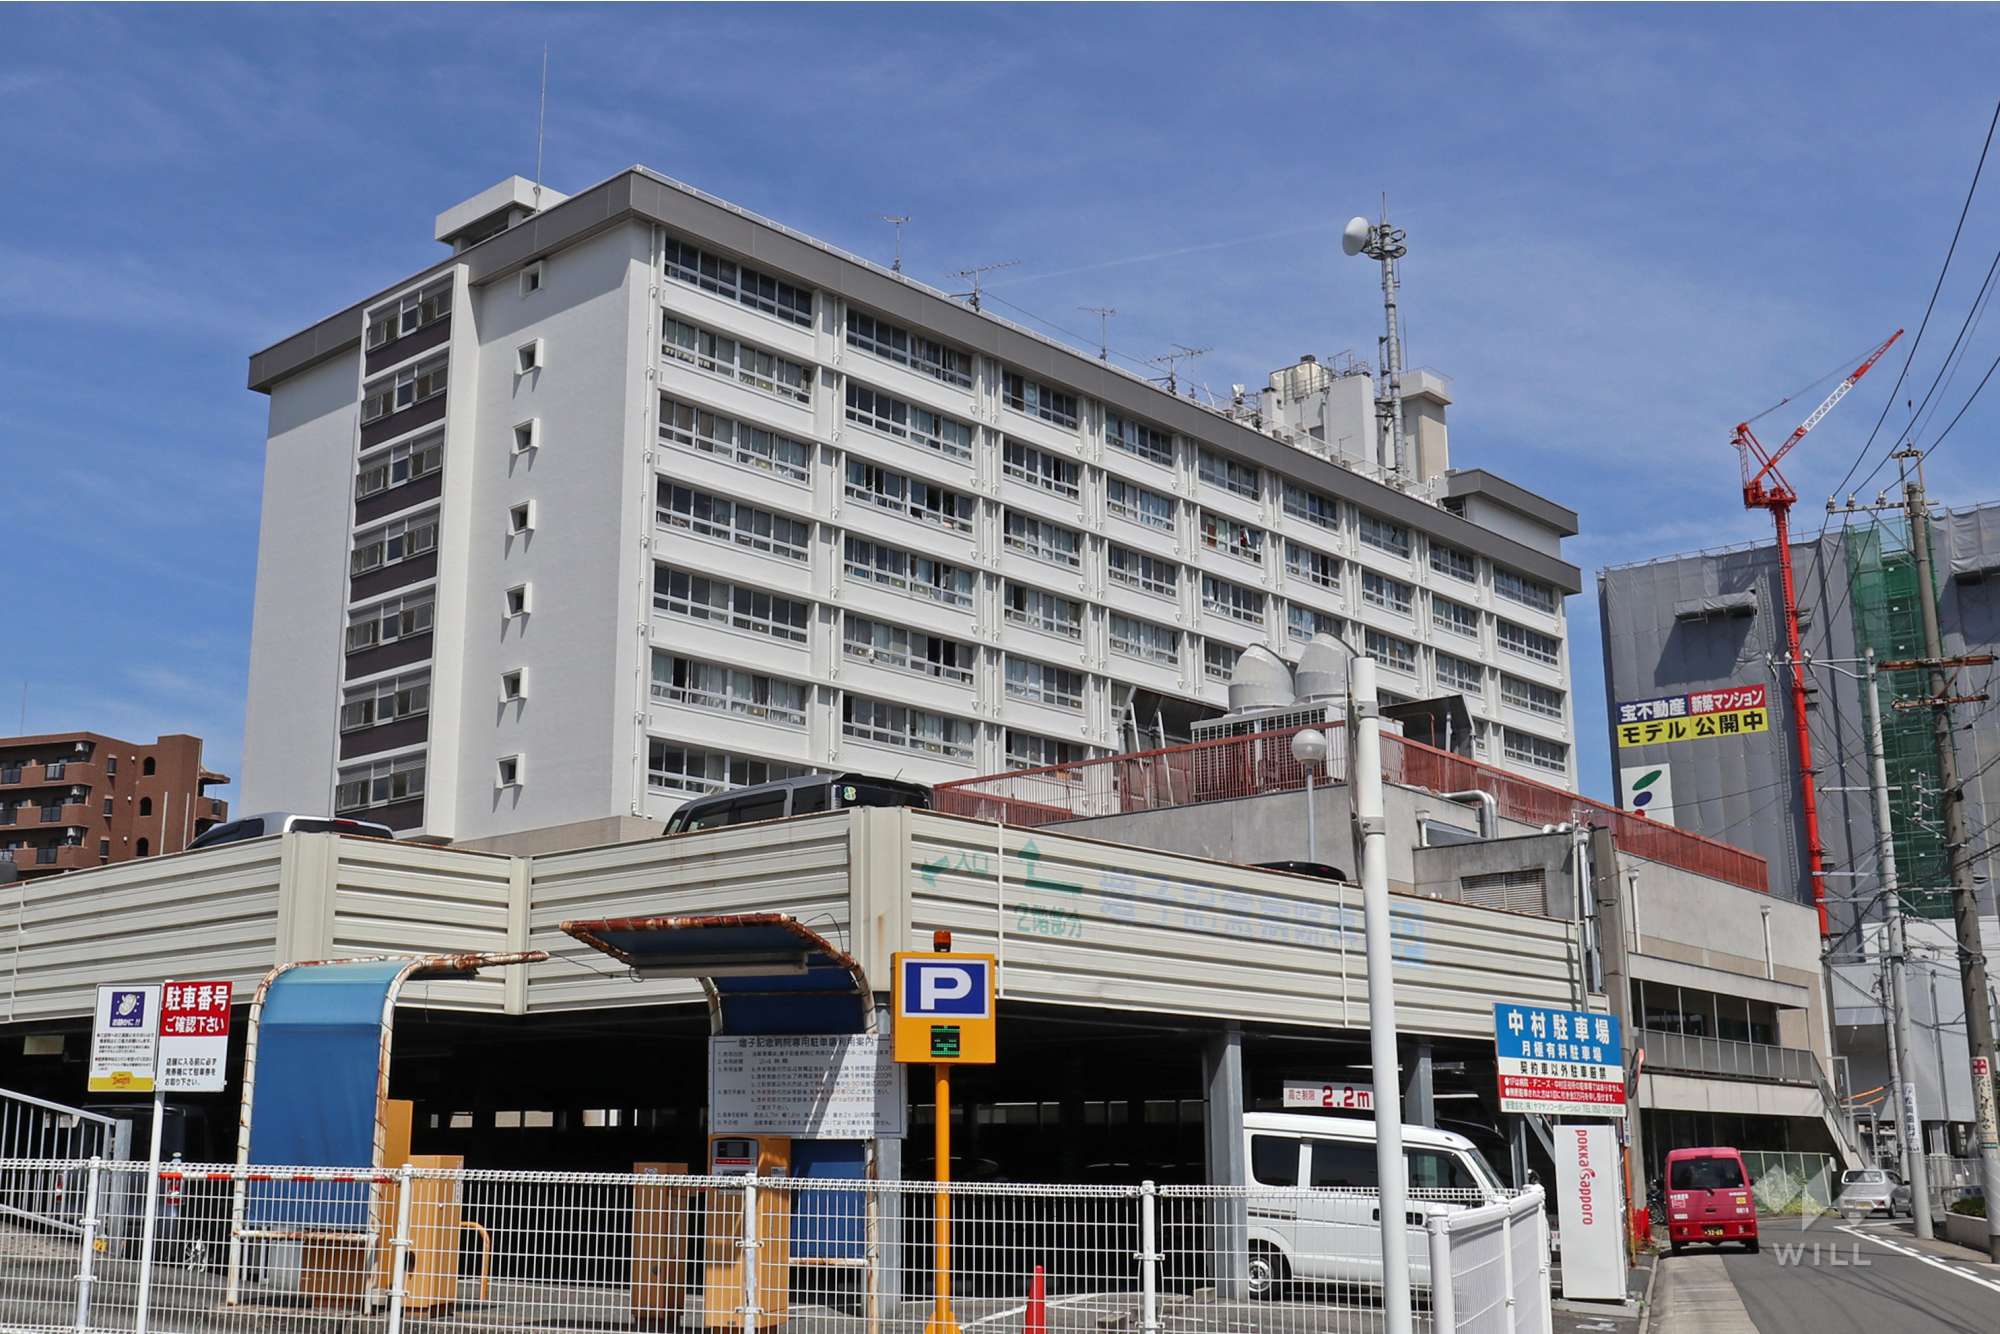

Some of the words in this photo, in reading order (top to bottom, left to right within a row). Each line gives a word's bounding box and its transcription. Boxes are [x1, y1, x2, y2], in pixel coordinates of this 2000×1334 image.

[1620, 697, 1686, 723] 宝不動産
[1690, 689, 1763, 714] 新築マンション
[1622, 721, 1687, 744] モデル
[1695, 711, 1763, 737] 公開中
[955, 850, 989, 875] 入口
[165, 985, 229, 1011] 駐車番号
[919, 966, 972, 1010] P
[165, 1016, 225, 1033] ご確認下さい
[1508, 1009, 1610, 1045] 中村駐車場
[1522, 1040, 1602, 1062] 月極有料駐車場
[1322, 1085, 1370, 1108] 2.2m
